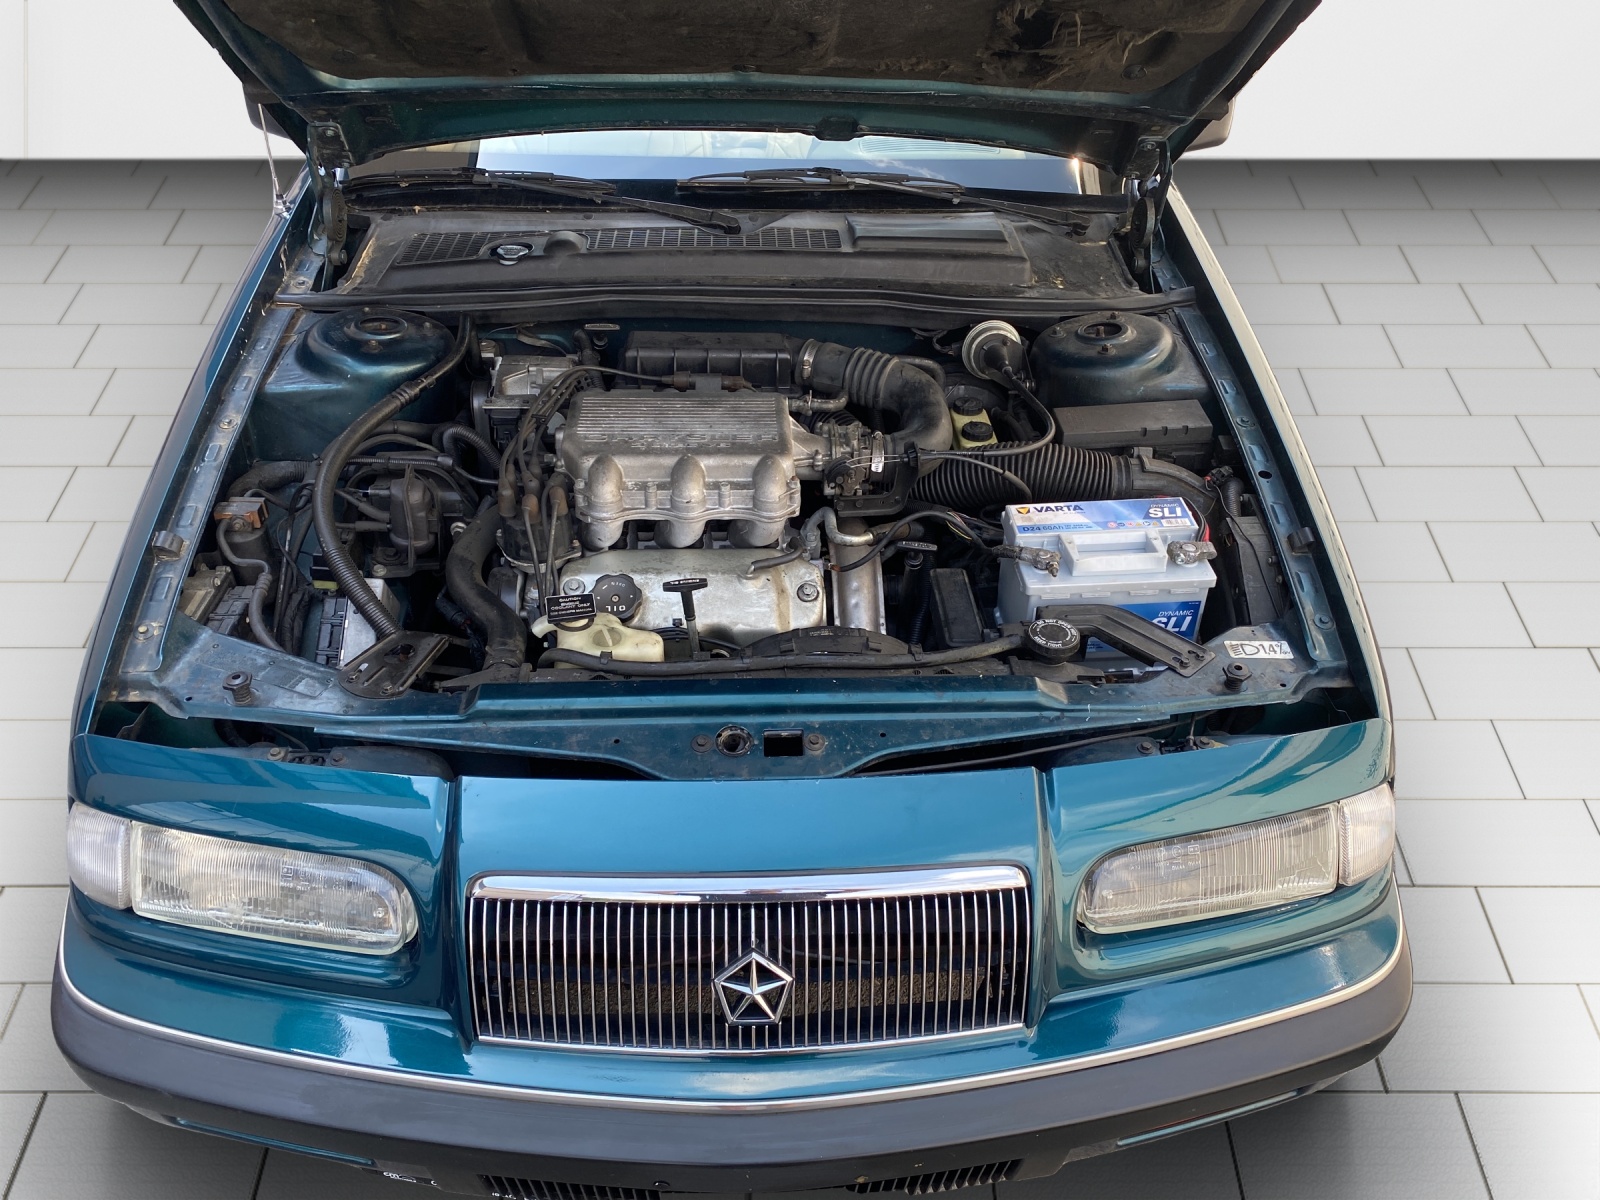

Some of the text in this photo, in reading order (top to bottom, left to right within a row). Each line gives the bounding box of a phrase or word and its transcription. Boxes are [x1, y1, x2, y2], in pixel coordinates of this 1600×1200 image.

[1033, 505, 1084, 513] VARTA
[1148, 507, 1182, 518] SLI
[1158, 609, 1194, 617] DYNAMIC
